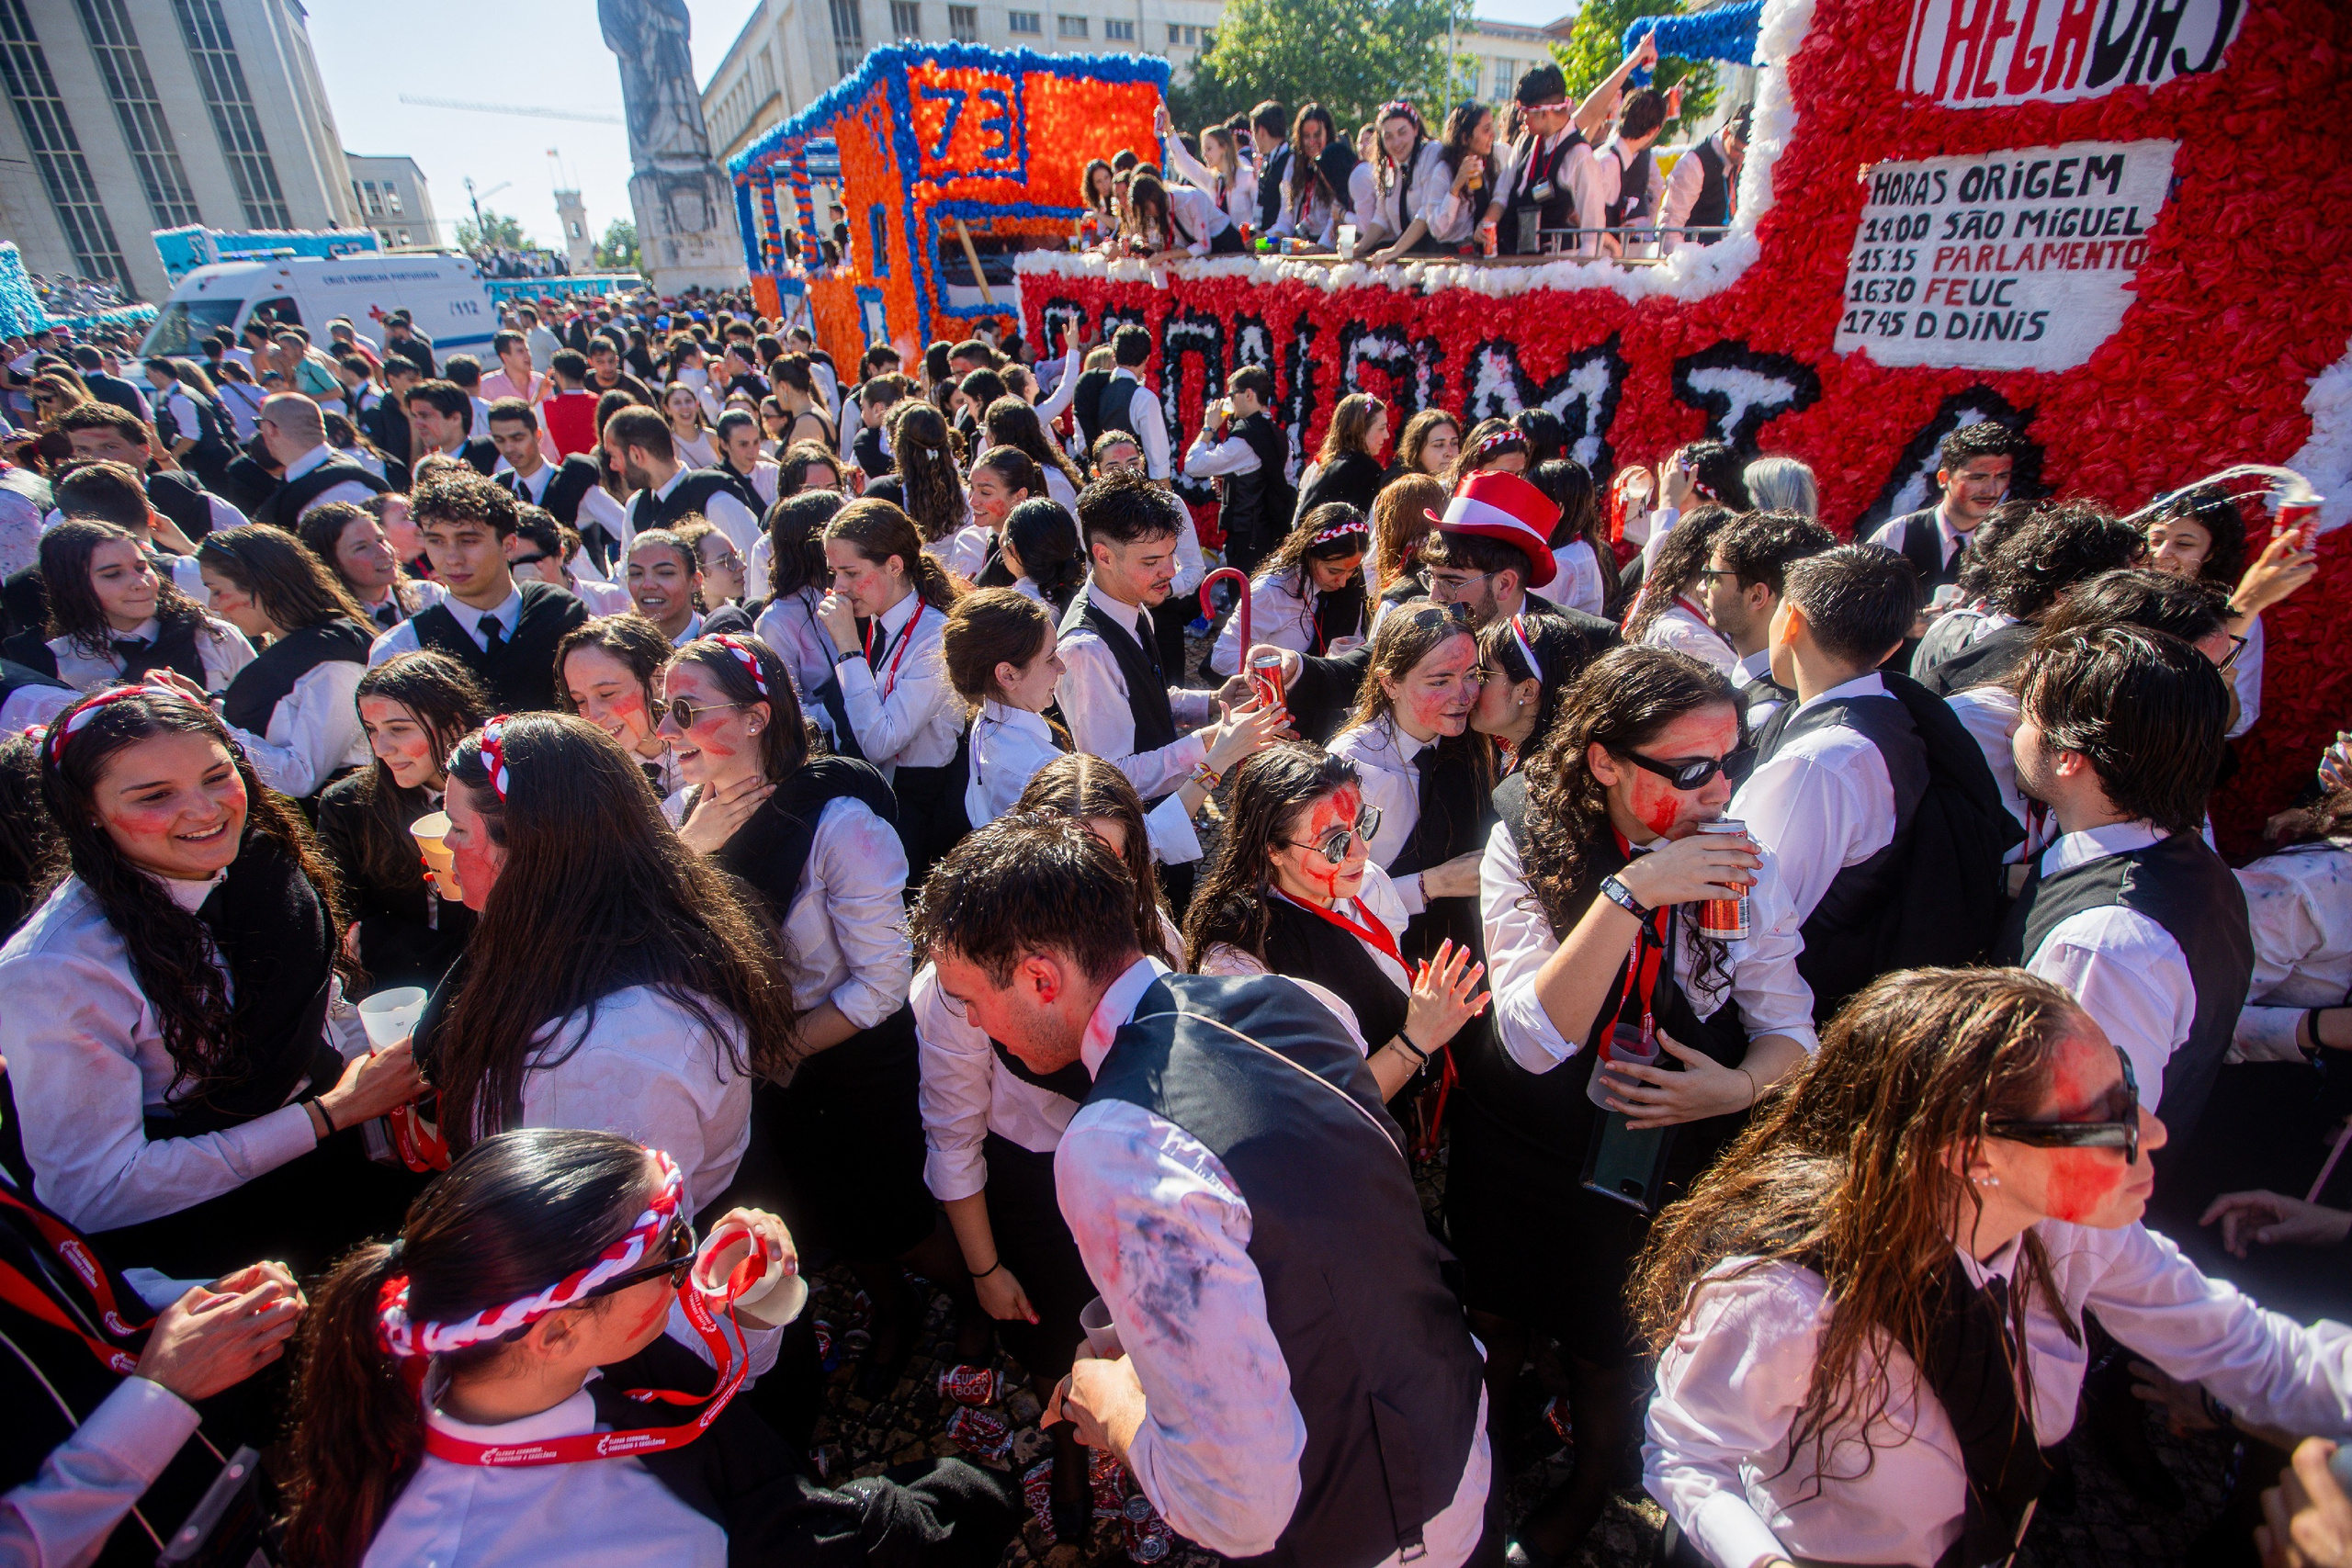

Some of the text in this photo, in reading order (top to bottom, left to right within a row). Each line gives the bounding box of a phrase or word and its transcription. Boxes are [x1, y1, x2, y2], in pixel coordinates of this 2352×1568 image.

[920, 87, 1011, 160] 73
[1871, 153, 2126, 206] HORAS ORIGEM
[1940, 210, 2005, 241] SÃO
[2013, 206, 2144, 238] MIGUEL
[1932, 238, 2149, 273] PARLAMENTO
[457, 299, 481, 316] 112
[1924, 278, 2018, 308] FEUC
[1944, 310, 2051, 343] DINIS
[955, 1372, 989, 1385] SUPER
[956, 1384, 987, 1396] BOCK
